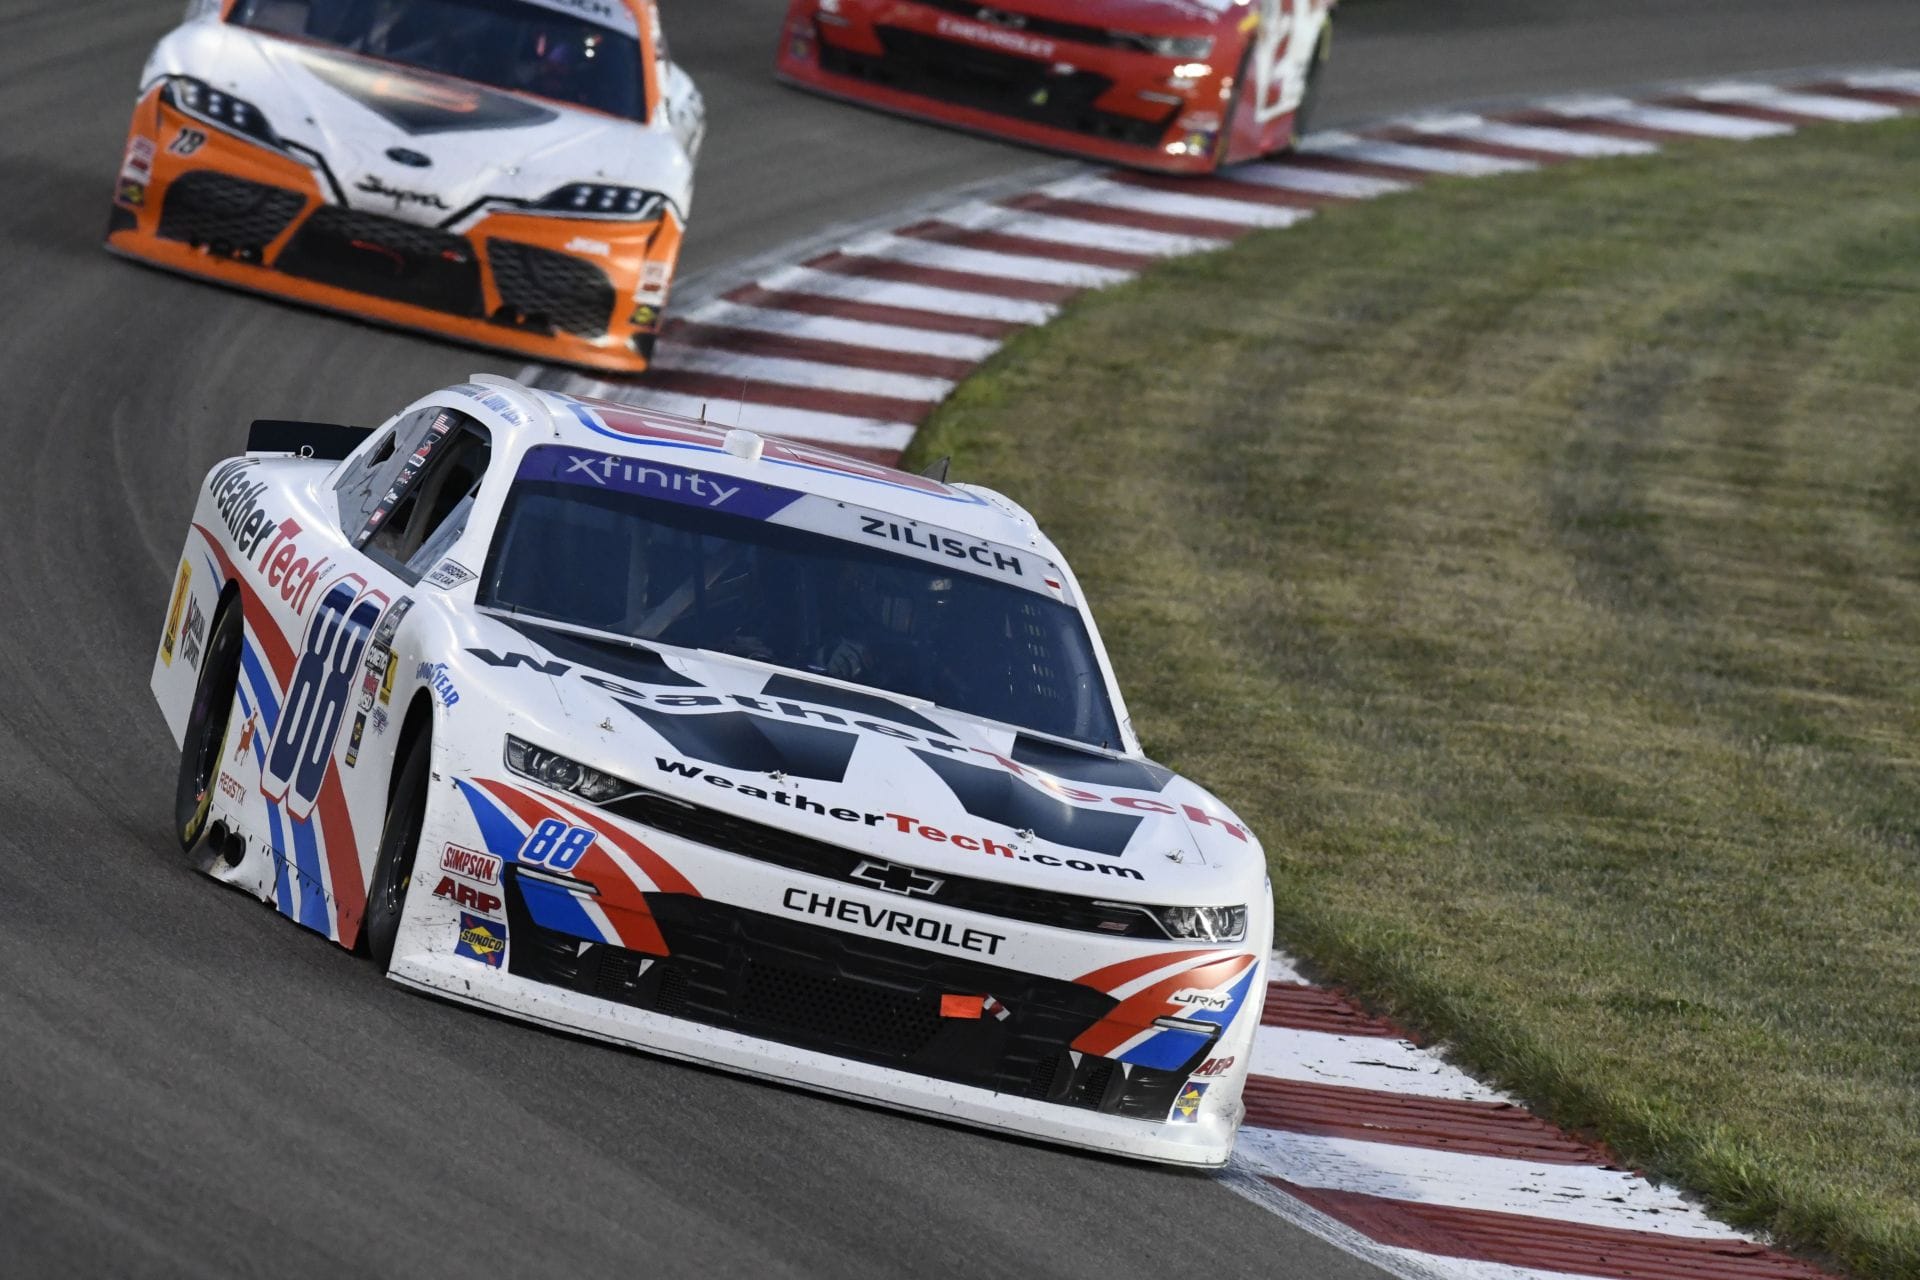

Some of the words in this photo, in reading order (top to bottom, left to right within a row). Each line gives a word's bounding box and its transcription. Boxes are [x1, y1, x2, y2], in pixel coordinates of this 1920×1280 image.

[566, 455, 741, 506] xfinity
[860, 515, 1023, 576] ZILISCH
[267, 580, 382, 805] 88
[443, 847, 496, 881] SIMPSON
[520, 817, 598, 872] 88
[432, 875, 502, 914] ARP
[461, 929, 504, 951] SUNOCO
[782, 886, 1007, 956] CHEVROLET
[1174, 994, 1226, 1009] JRM
